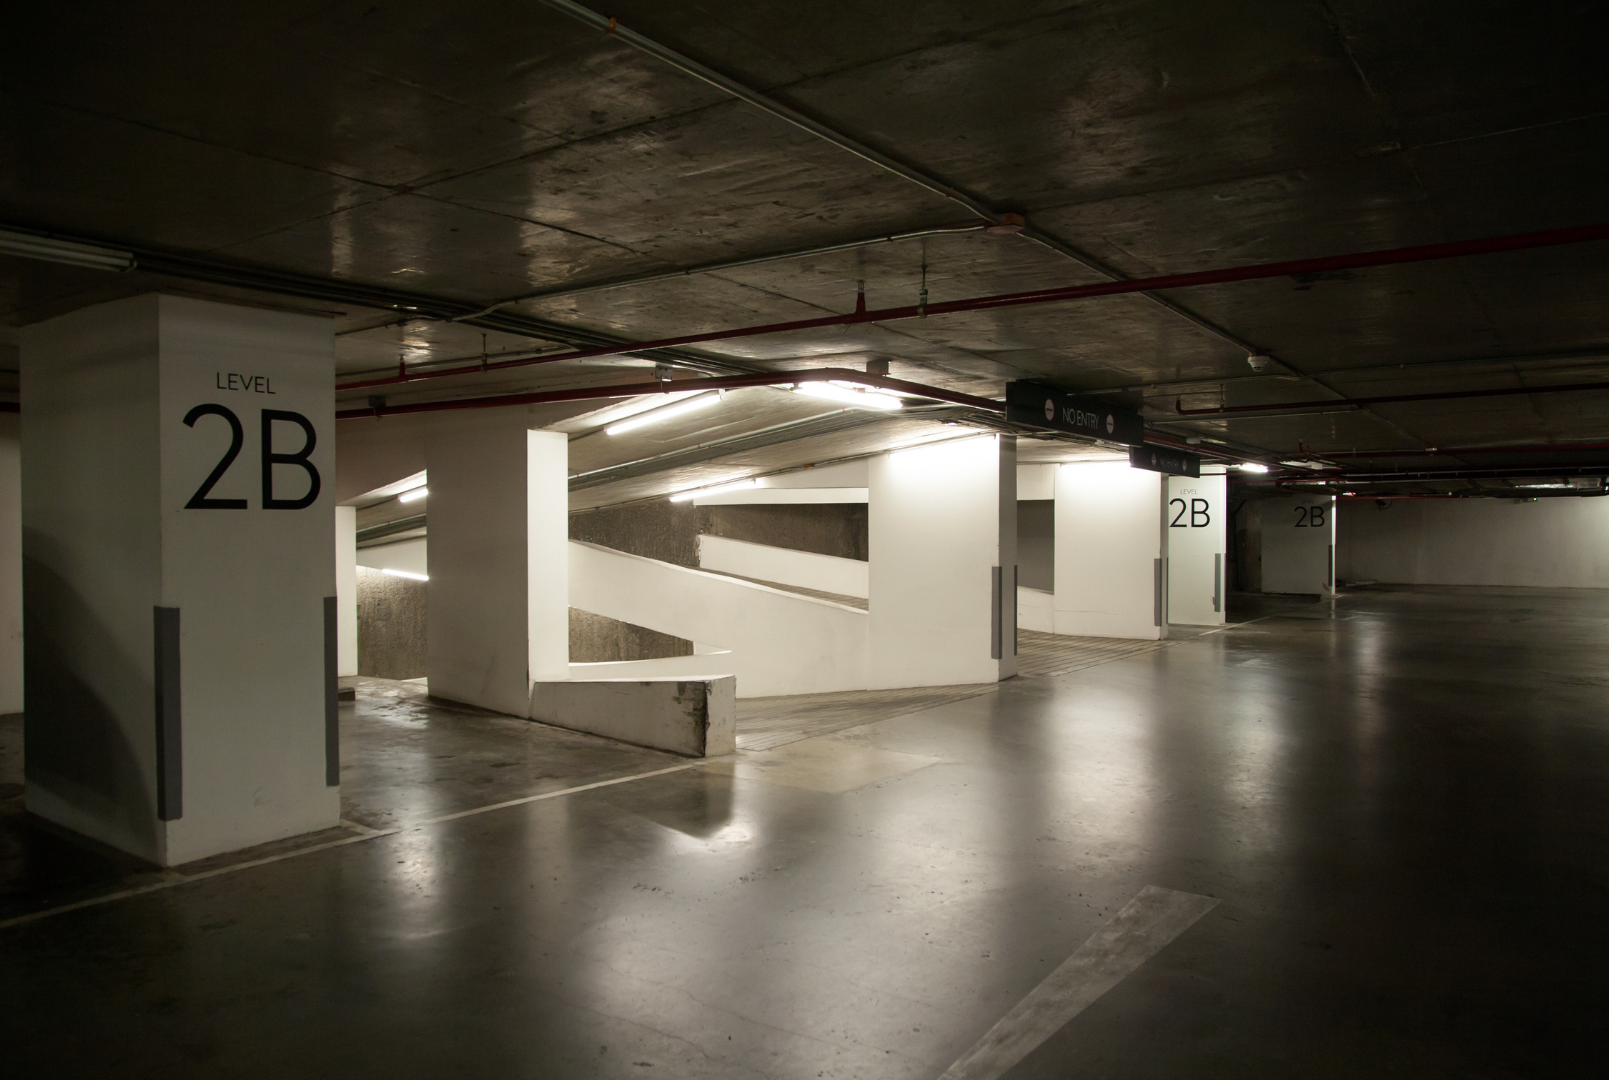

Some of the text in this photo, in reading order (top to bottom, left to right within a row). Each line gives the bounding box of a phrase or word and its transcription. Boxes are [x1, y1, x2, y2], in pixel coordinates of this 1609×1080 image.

[216, 372, 276, 395] LEVEL
[1062, 406, 1100, 430] NO ENTRY
[182, 403, 322, 510] 2B
[1169, 498, 1211, 528] 2B
[1294, 506, 1325, 528] 2B
